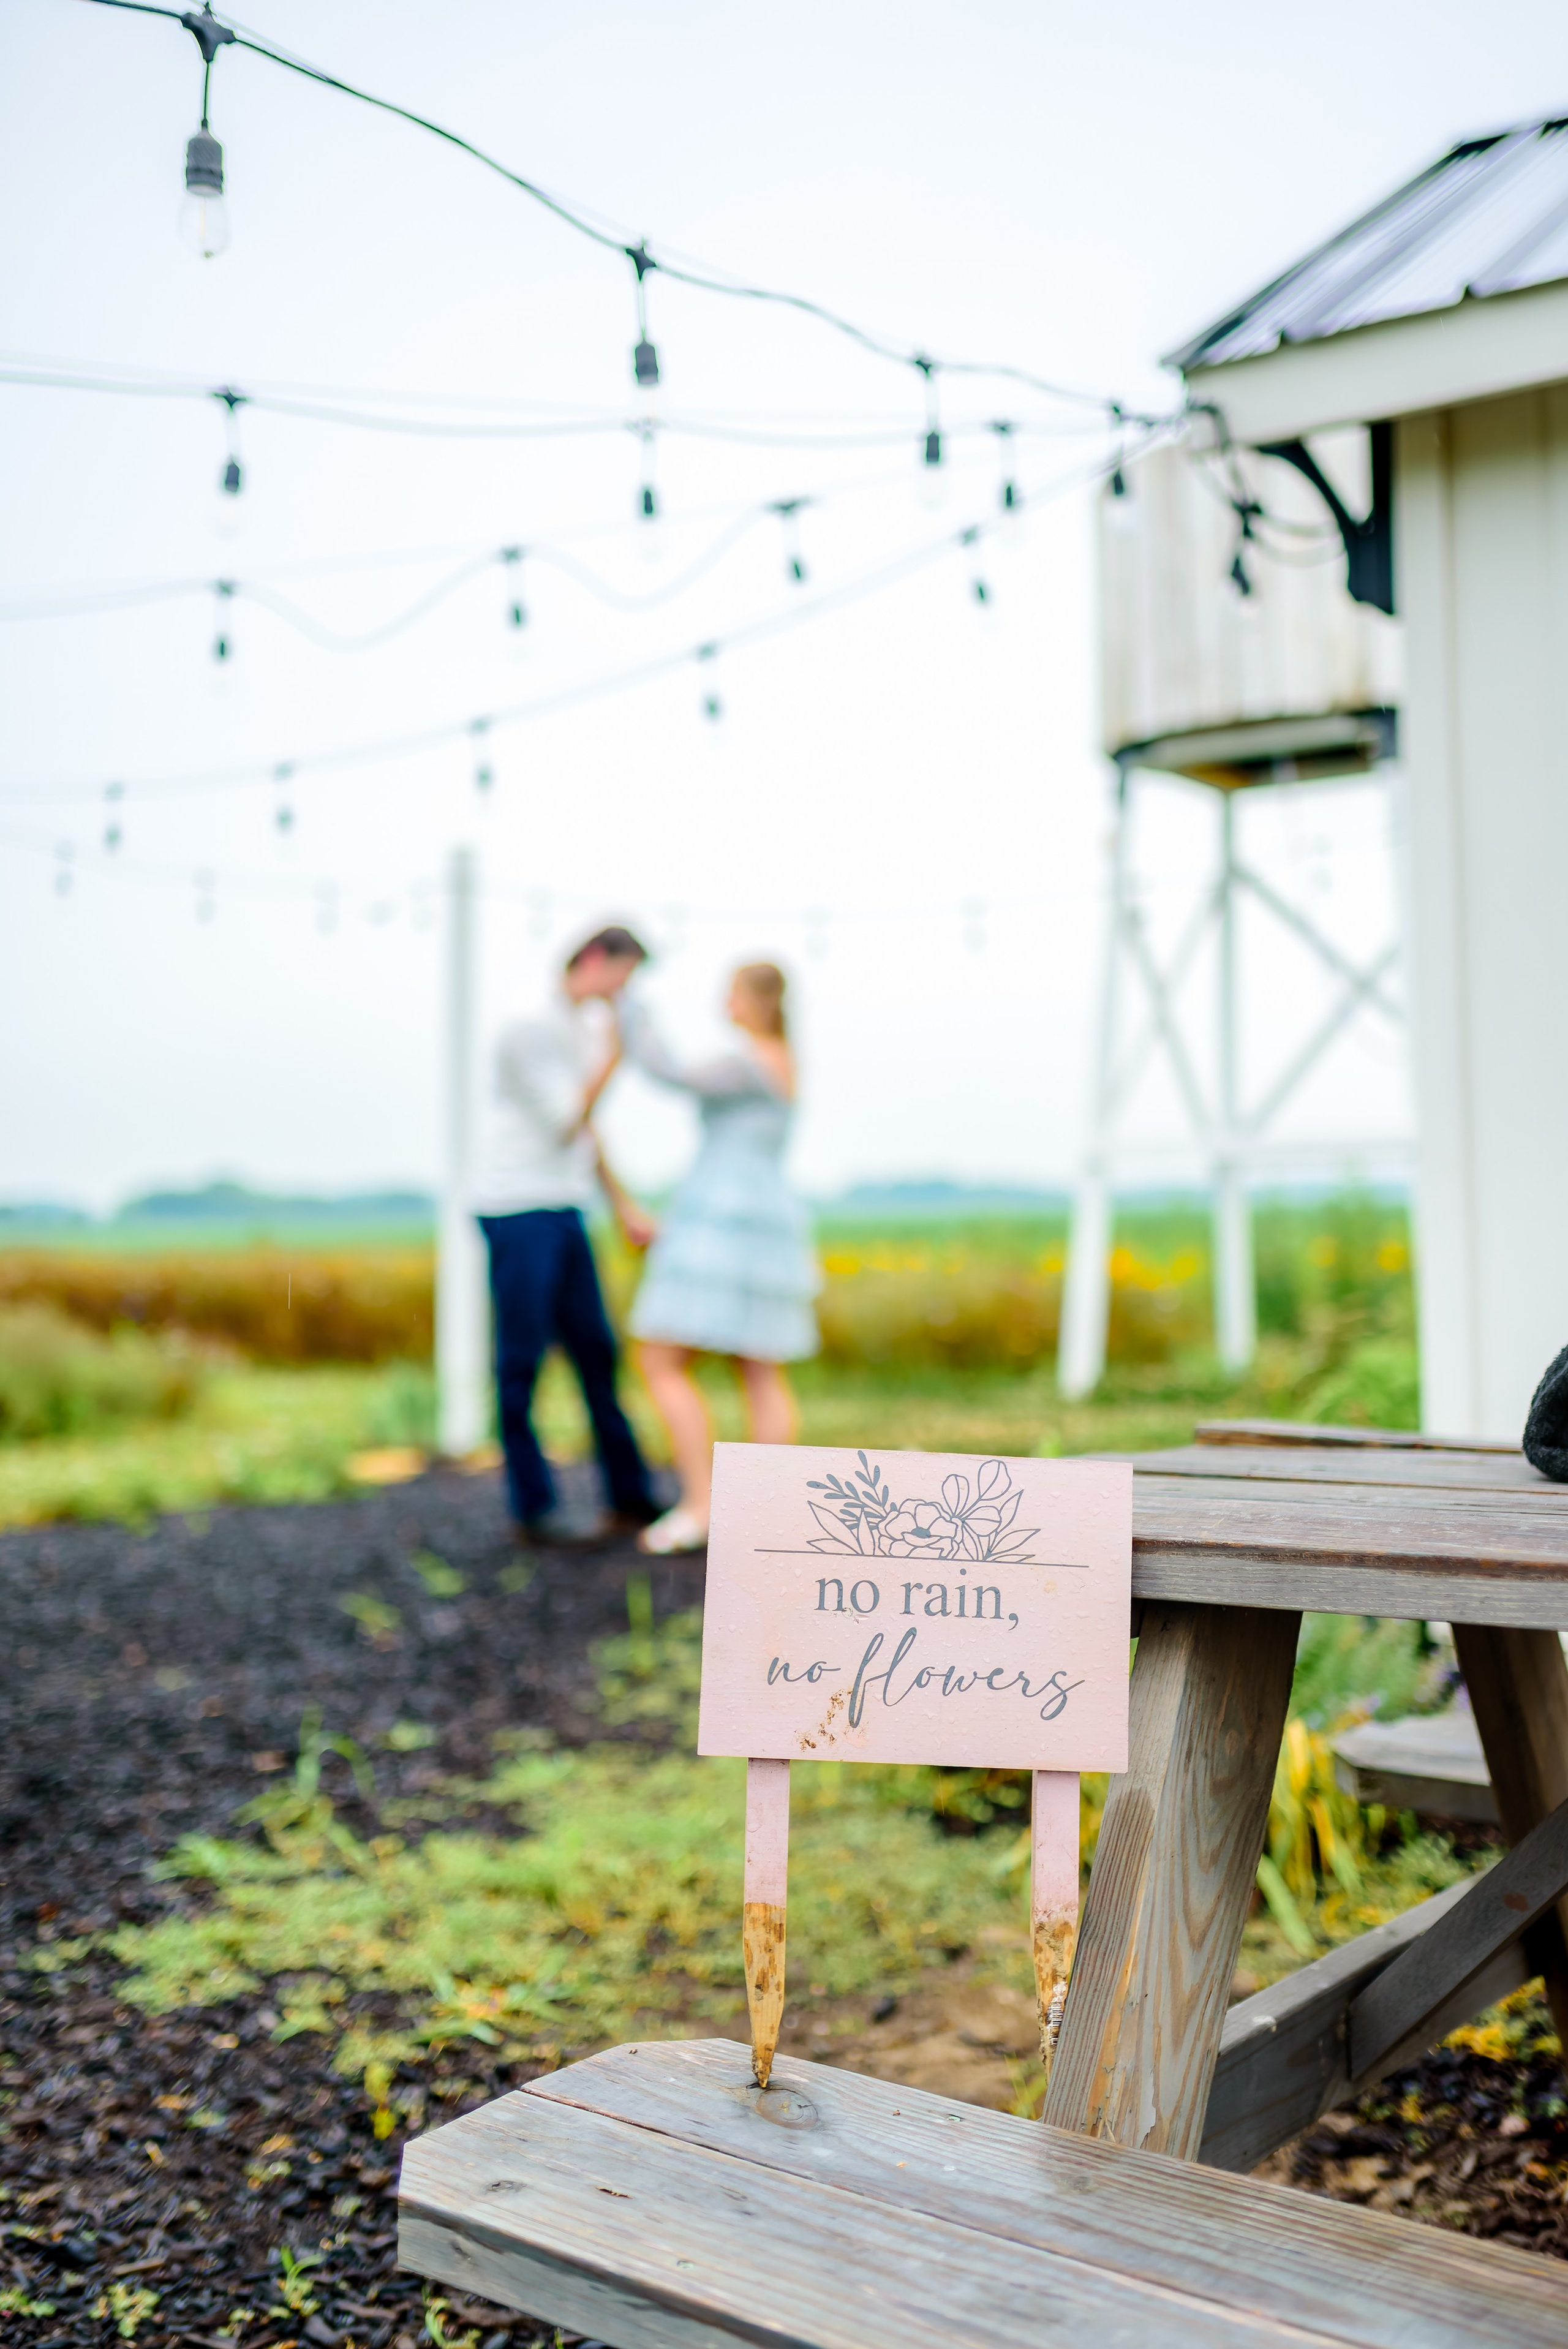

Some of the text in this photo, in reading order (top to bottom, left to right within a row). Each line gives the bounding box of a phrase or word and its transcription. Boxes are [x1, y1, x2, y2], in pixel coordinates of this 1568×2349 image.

[814, 1568, 1019, 1631] no rain,
[767, 1627, 1085, 1729] no flowers
